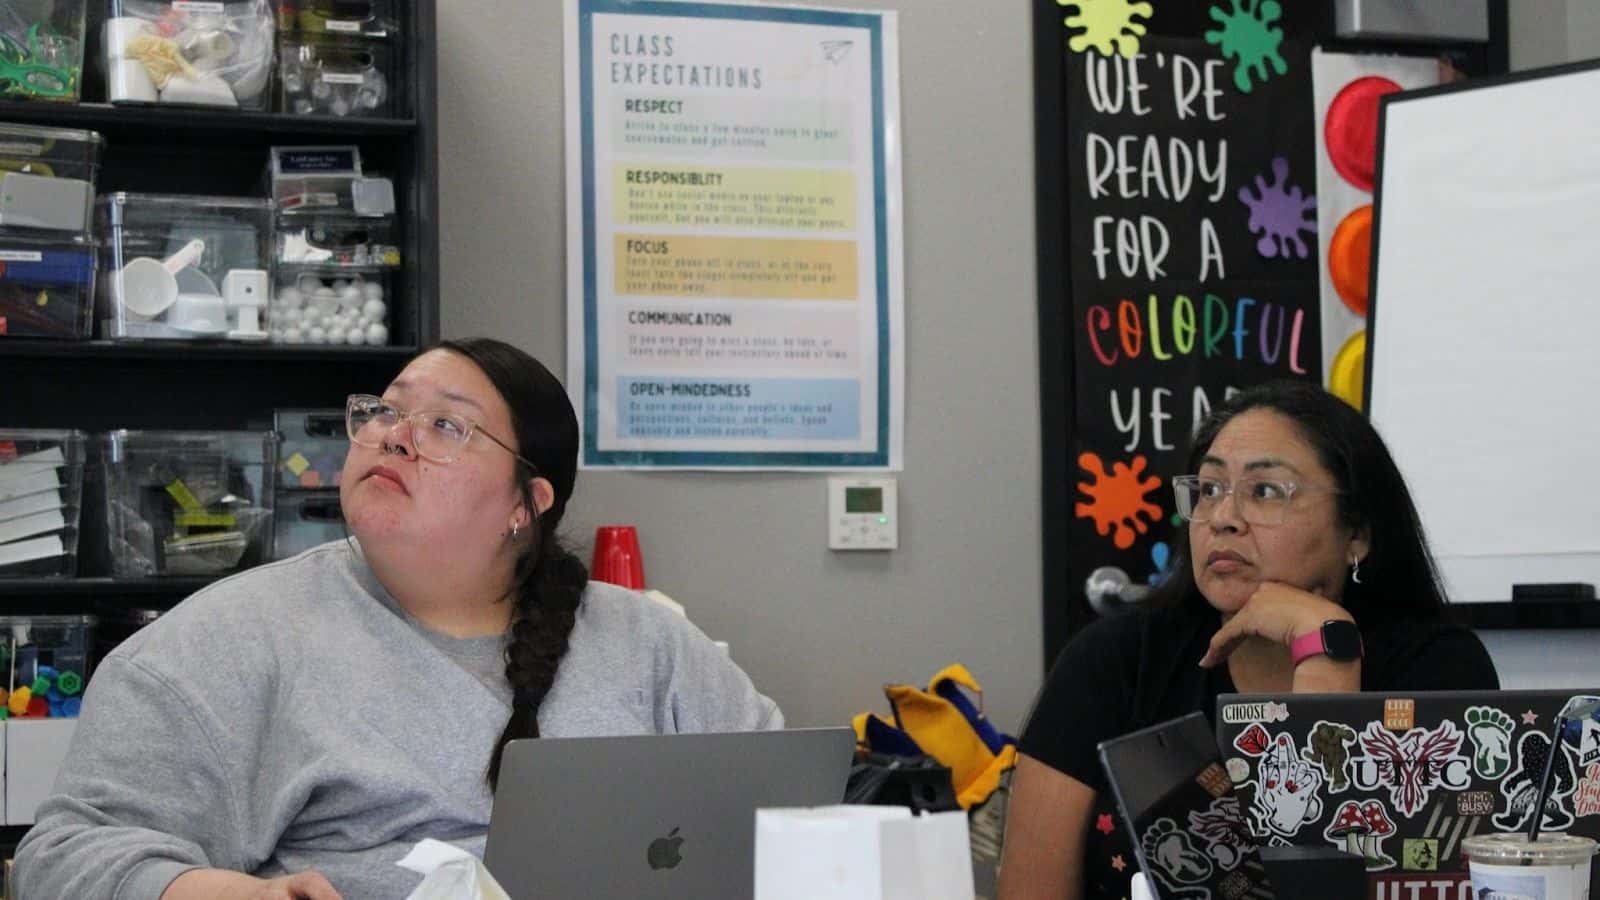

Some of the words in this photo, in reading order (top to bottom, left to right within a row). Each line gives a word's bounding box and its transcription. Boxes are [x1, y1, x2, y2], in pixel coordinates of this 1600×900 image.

[610, 33, 675, 56] CLASS
[610, 62, 763, 89] EXPECTATIONS
[1085, 51, 1227, 121] WE'RE
[625, 99, 684, 114] RESPECT
[1086, 133, 1228, 202] READY
[627, 239, 669, 254] FOCUS
[1092, 216, 1171, 281] FOR
[1200, 217, 1225, 283] A
[628, 311, 732, 326] COMMUNICATION
[1086, 294, 1307, 374] COLORFUL
[630, 382, 751, 398] OPEN-MINDEDNESS
[1109, 386, 1241, 452] YEA
[1225, 704, 1266, 720] CHOOSE
[1461, 802, 1491, 812] BUSY
